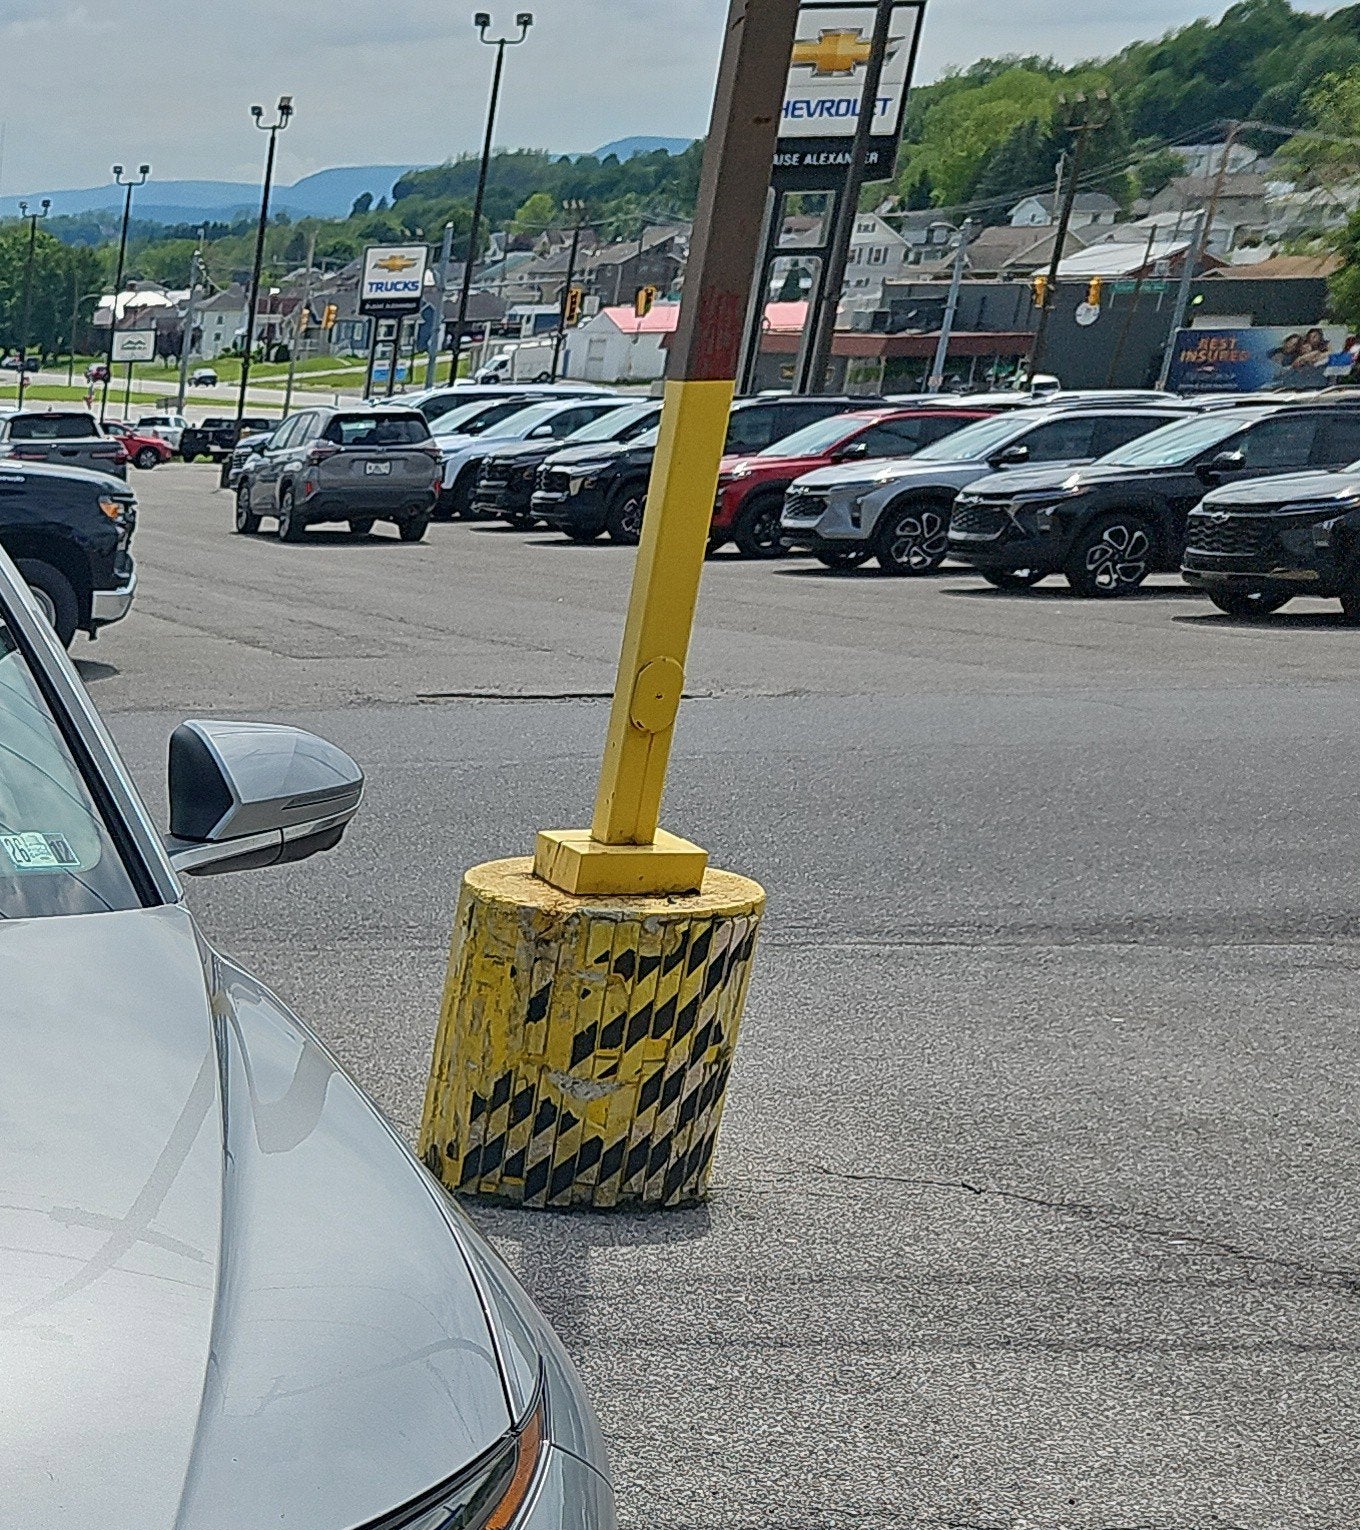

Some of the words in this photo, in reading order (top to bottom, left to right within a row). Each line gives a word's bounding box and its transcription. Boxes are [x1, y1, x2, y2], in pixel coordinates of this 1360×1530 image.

[782, 98, 894, 118] HEVROLT
[368, 280, 419, 292] TRUCKS
[4, 836, 31, 862] 26
